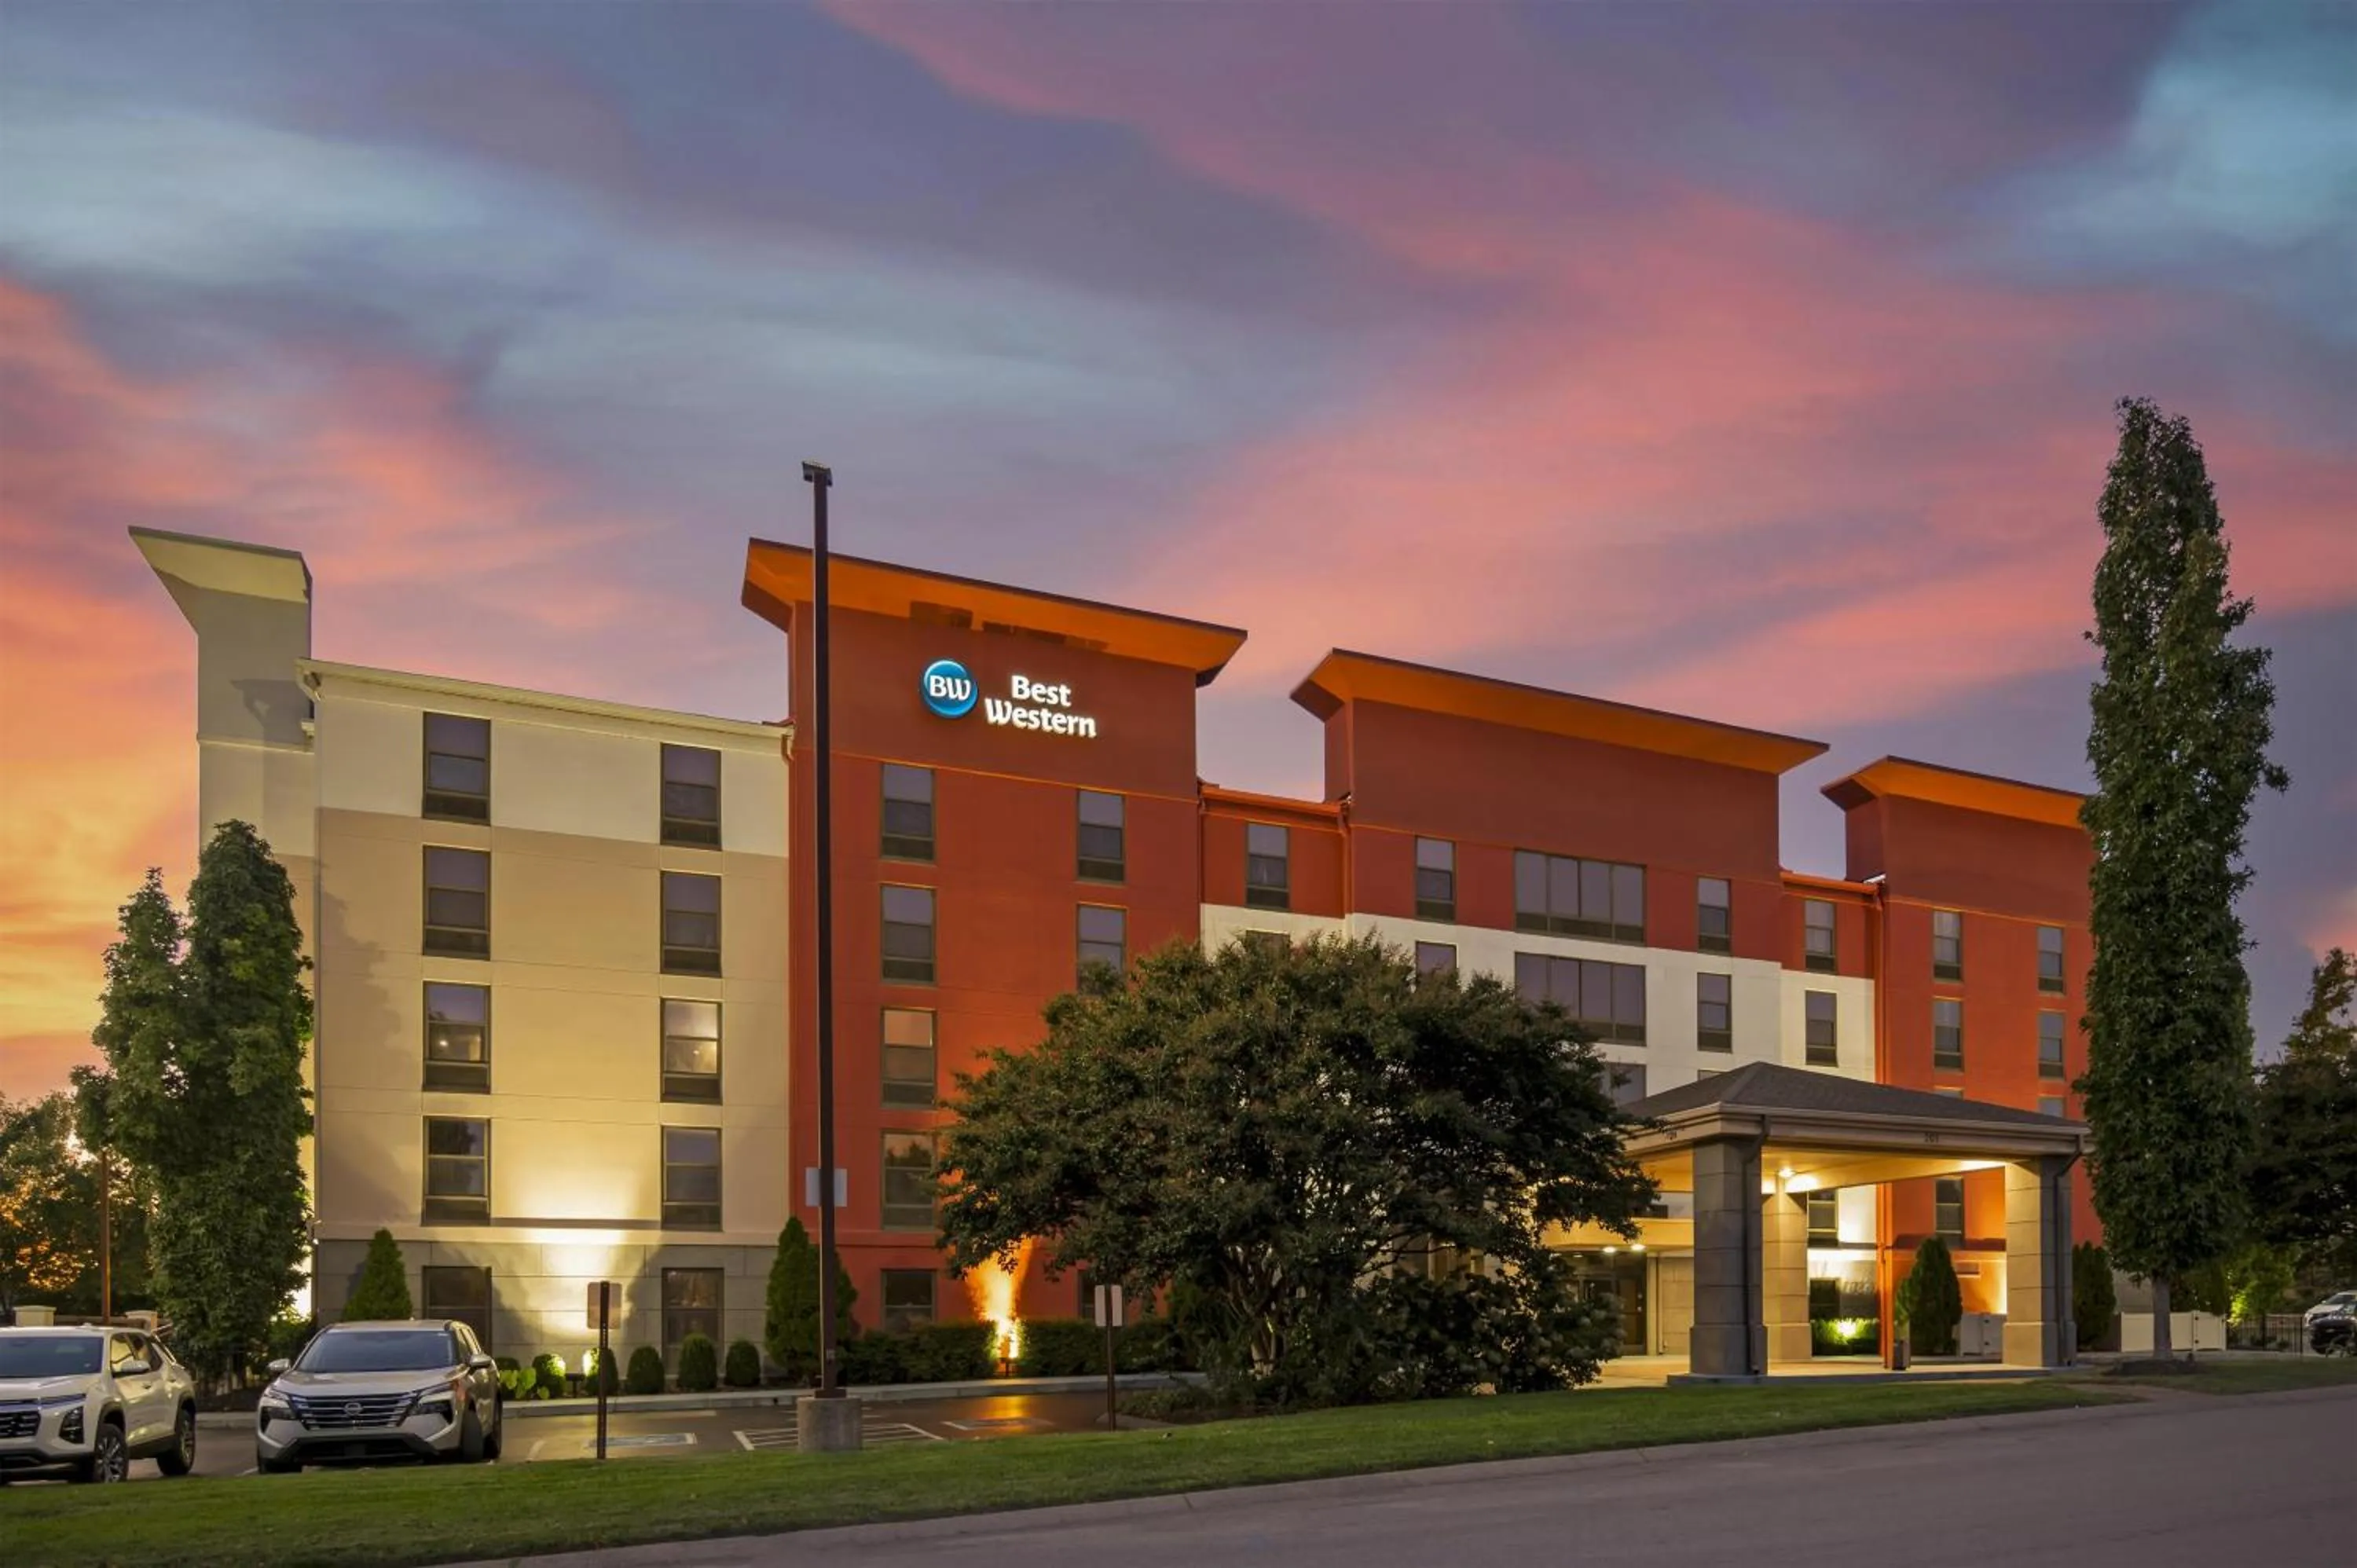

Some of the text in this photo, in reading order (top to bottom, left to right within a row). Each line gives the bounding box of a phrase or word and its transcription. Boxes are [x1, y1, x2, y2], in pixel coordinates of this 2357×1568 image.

[929, 675, 971, 701] BW
[1011, 675, 1072, 707] Best
[984, 698, 1097, 738] Western
